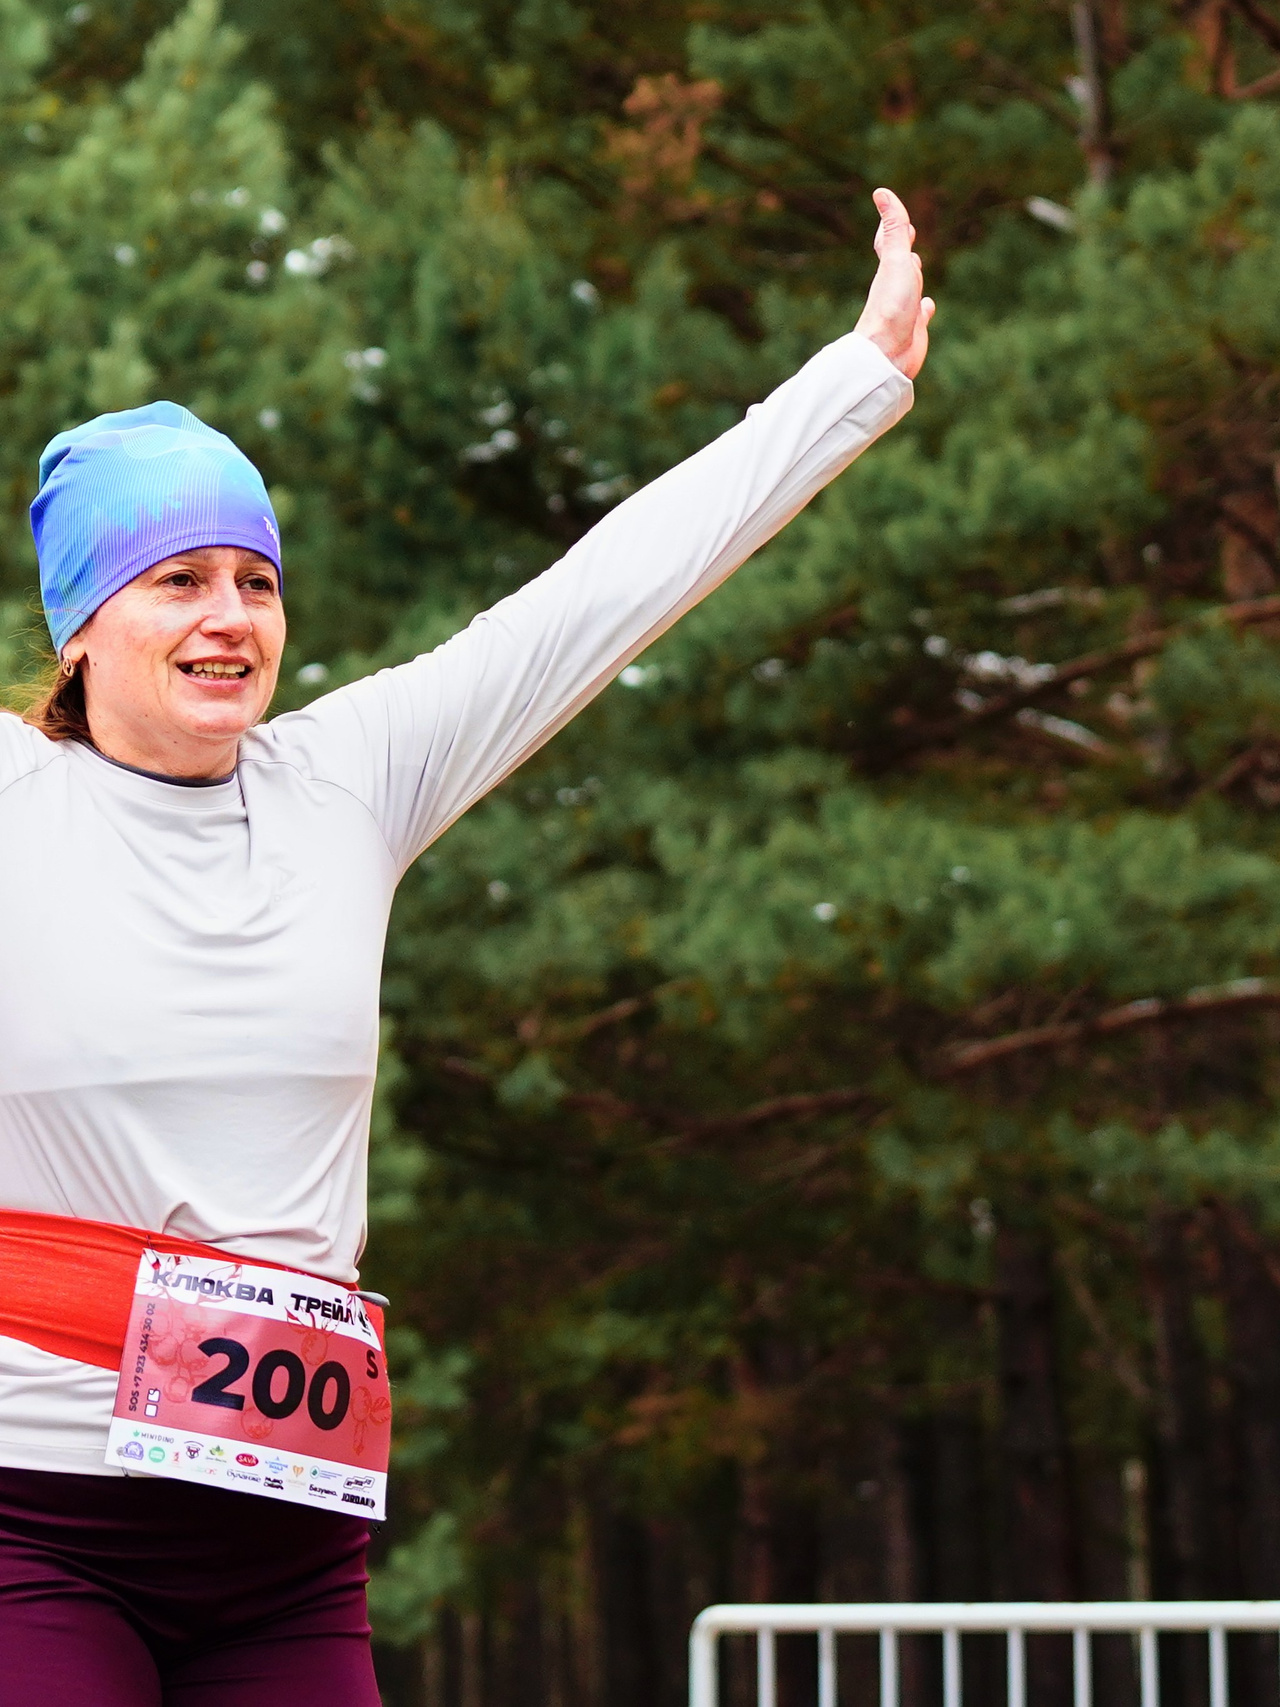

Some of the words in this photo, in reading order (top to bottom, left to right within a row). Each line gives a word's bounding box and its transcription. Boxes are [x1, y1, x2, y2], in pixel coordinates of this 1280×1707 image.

[152, 1270, 274, 1306] КЛЮКВА
[290, 1293, 355, 1326] ТРЕЙЛ
[146, 1302, 155, 1316] 02
[143, 1317, 152, 1331] 30
[139, 1333, 150, 1353] 434
[135, 1354, 146, 1374] 923
[366, 1349, 379, 1379] S
[133, 1375, 142, 1388] +7
[191, 1337, 351, 1431] 200
[128, 1389, 140, 1412] SOS
[141, 1432, 175, 1444] MINIDINO
